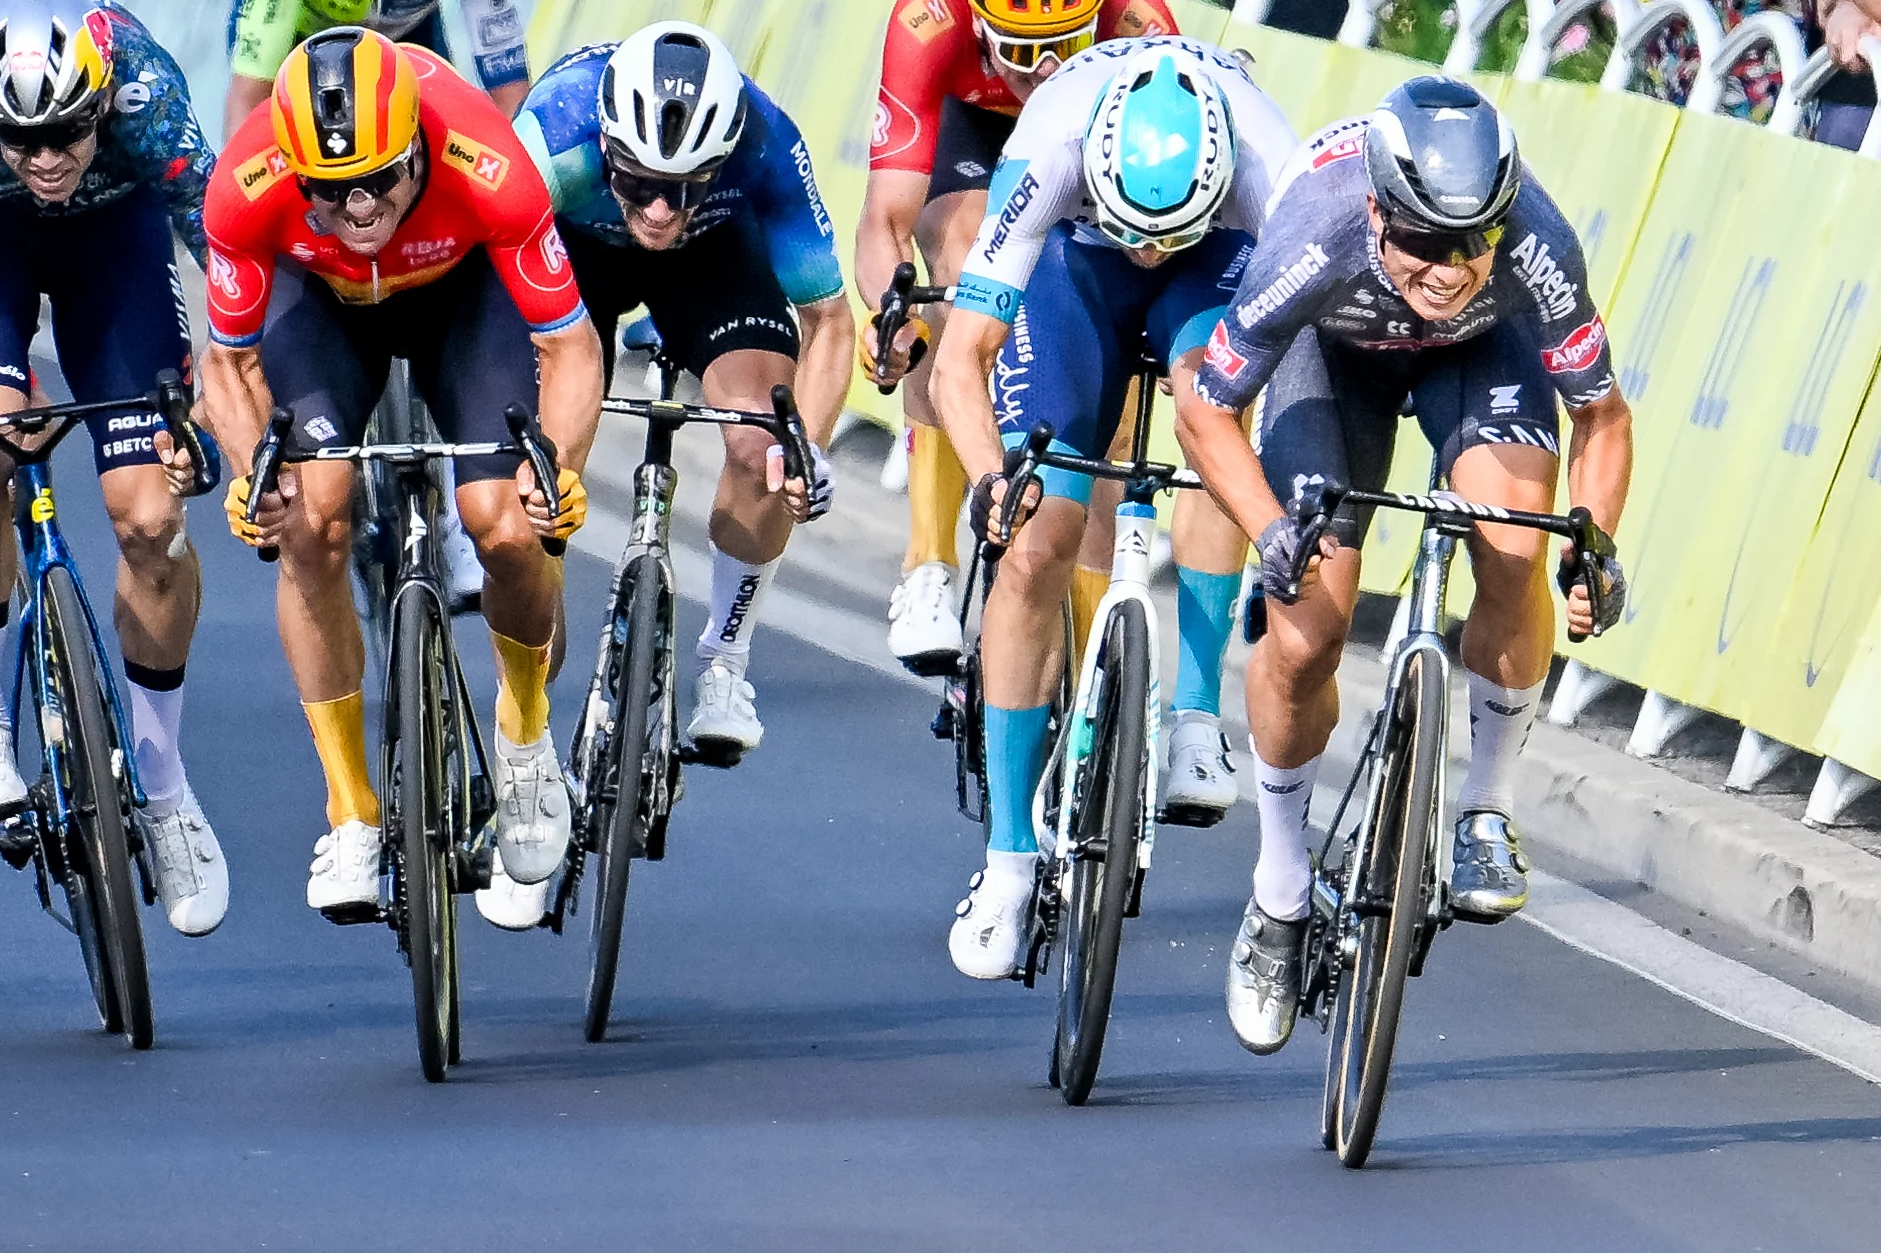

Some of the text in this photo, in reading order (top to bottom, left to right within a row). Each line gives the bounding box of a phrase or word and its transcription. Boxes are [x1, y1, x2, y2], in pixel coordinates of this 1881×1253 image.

[243, 165, 268, 189] Uno
[448, 142, 475, 164] Uno
[789, 140, 834, 238] MONDIALE
[983, 171, 1040, 265] MERIDA
[1236, 241, 1331, 331] deceuninck
[1509, 231, 1578, 321] Alpecin
[709, 315, 793, 342] VAN RYSEL
[1551, 321, 1604, 367] Alpecin
[720, 573, 761, 643] DECATHLON
